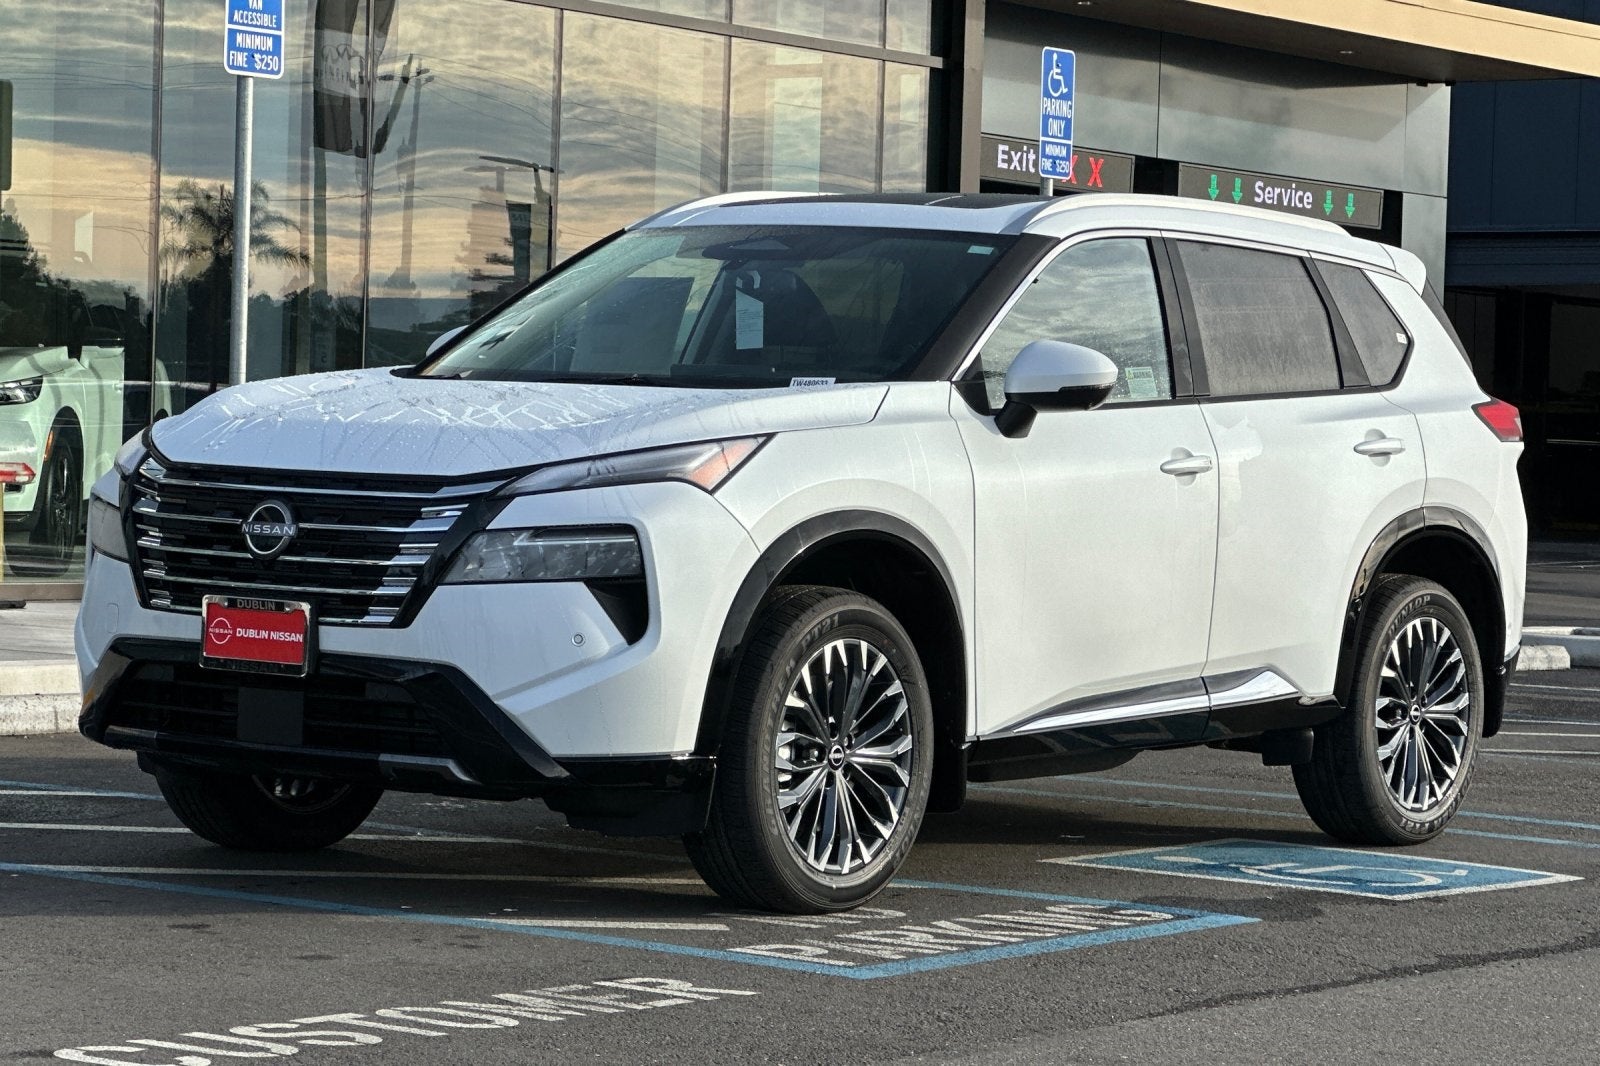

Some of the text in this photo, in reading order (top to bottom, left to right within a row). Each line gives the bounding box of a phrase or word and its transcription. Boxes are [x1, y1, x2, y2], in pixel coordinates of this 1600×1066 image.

[248, 0, 263, 11] VAN
[233, 10, 277, 28] ACCESSIBLE
[236, 33, 273, 52] MINIMUM
[229, 51, 279, 71] FINE $250
[1042, 97, 1072, 119] PARKING
[1048, 118, 1066, 138] ONLY
[997, 144, 1036, 174] Exit
[1045, 143, 1067, 158] MINIMUM
[1041, 158, 1070, 174] FINE $250
[1253, 180, 1313, 209] Service
[241, 523, 295, 536] NISSAN
[236, 599, 276, 611] DUBLIN
[1387, 595, 1432, 639] DUNLOP
[208, 627, 233, 636] NISSAN
[236, 628, 304, 643] DUBLIN NISSAN
[801, 612, 839, 650] PT21
[725, 904, 1154, 967] PARKING
[53, 976, 762, 1066] CUSTOMER
